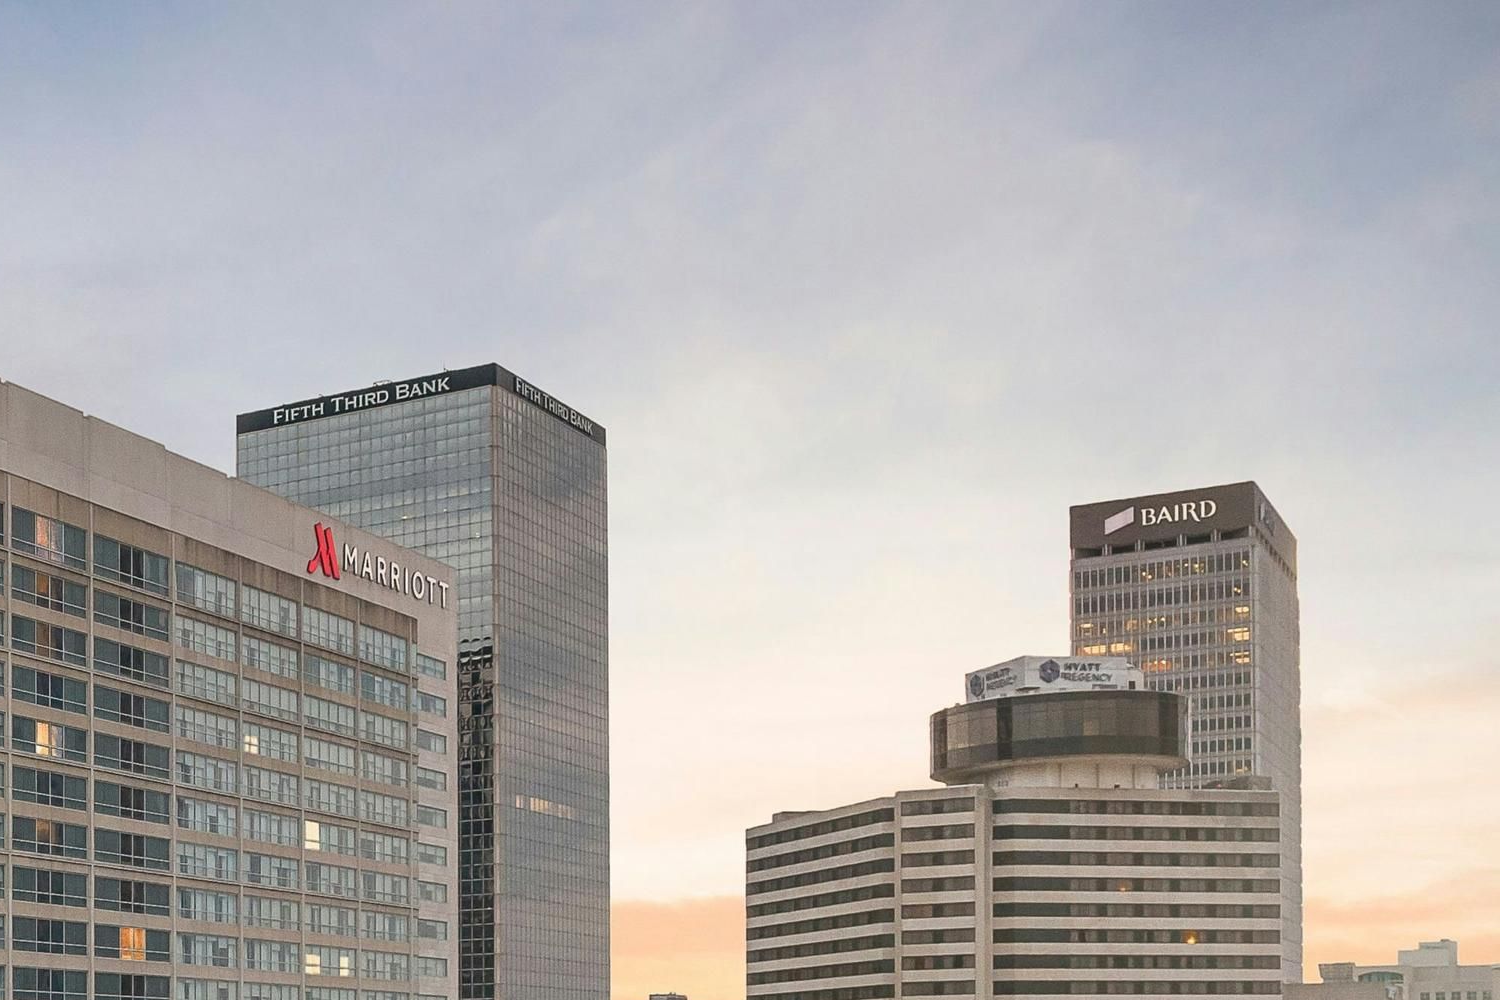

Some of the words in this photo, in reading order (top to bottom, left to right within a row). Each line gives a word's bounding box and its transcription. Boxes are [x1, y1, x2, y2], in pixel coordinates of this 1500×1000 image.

[273, 402, 325, 425] FIFTH
[331, 390, 389, 412] THIRD
[395, 376, 450, 400] BANK
[516, 376, 540, 404] FIFTH
[543, 393, 569, 420] THIRD
[570, 410, 593, 435] BANK
[1140, 500, 1217, 526] BAIRD
[343, 543, 449, 608] MARRIOTT
[1062, 672, 1113, 682] REGENCY
[1063, 662, 1102, 672] HYATT
